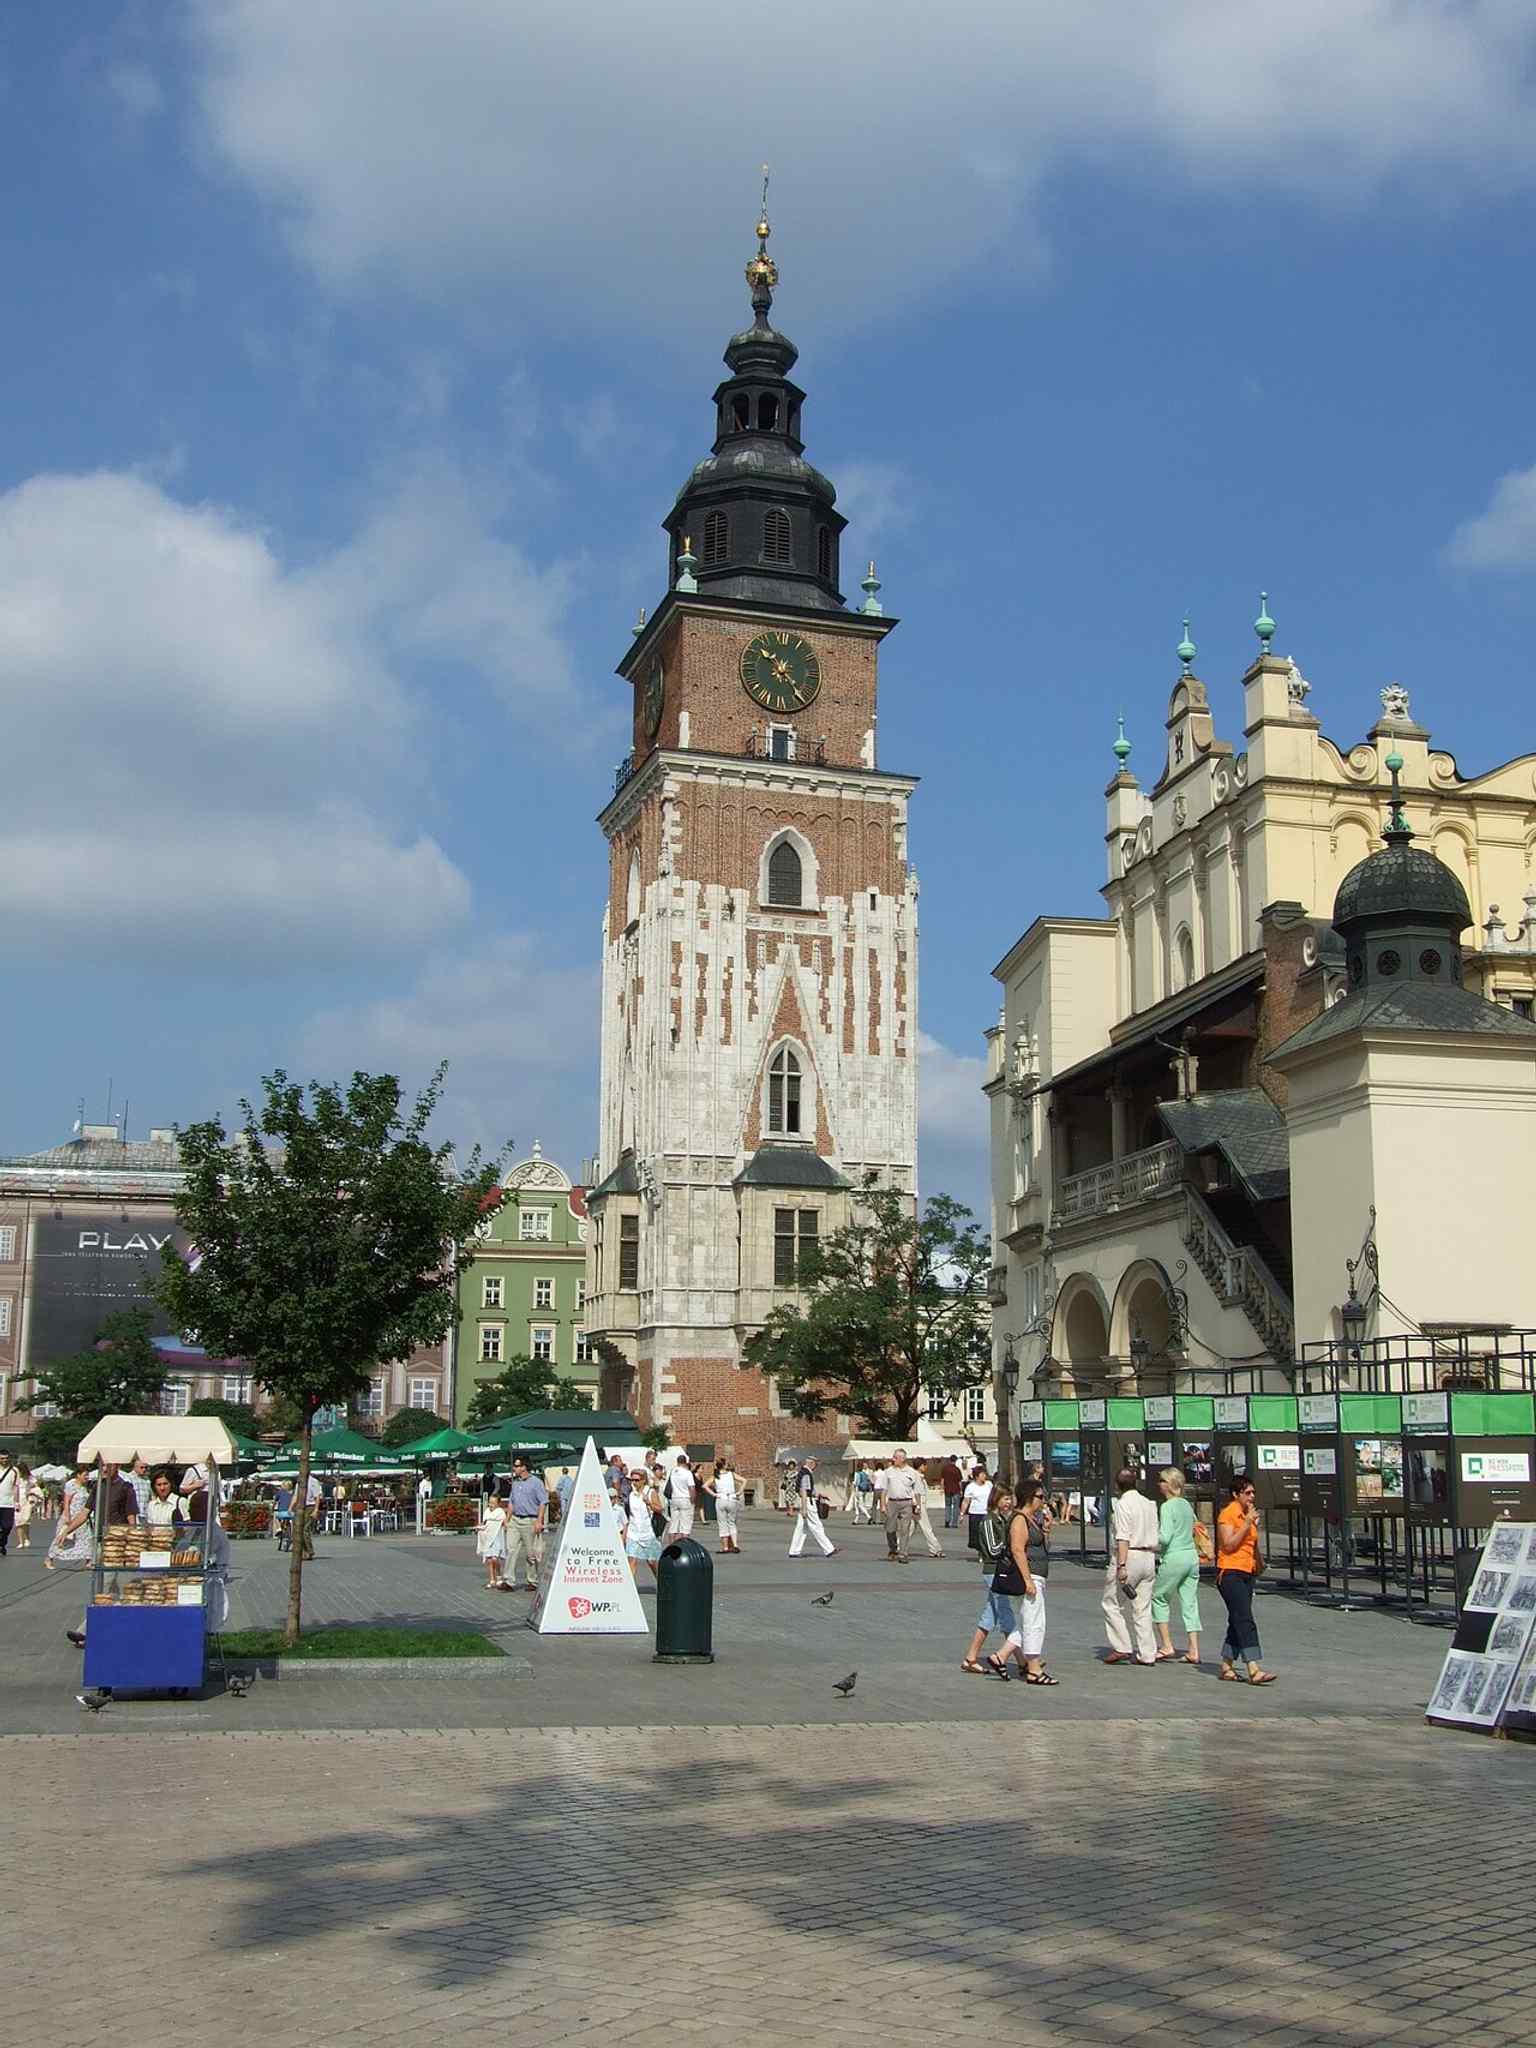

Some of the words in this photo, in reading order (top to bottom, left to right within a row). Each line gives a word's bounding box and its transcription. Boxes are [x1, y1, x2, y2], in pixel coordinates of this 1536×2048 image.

[79, 1231, 172, 1251] PLAY
[571, 1547, 615, 1556] Welcome
[588, 1556, 619, 1566] Free
[566, 1566, 622, 1575] Wireless
[564, 1576, 599, 1584] Internet
[602, 1576, 624, 1584] Zone
